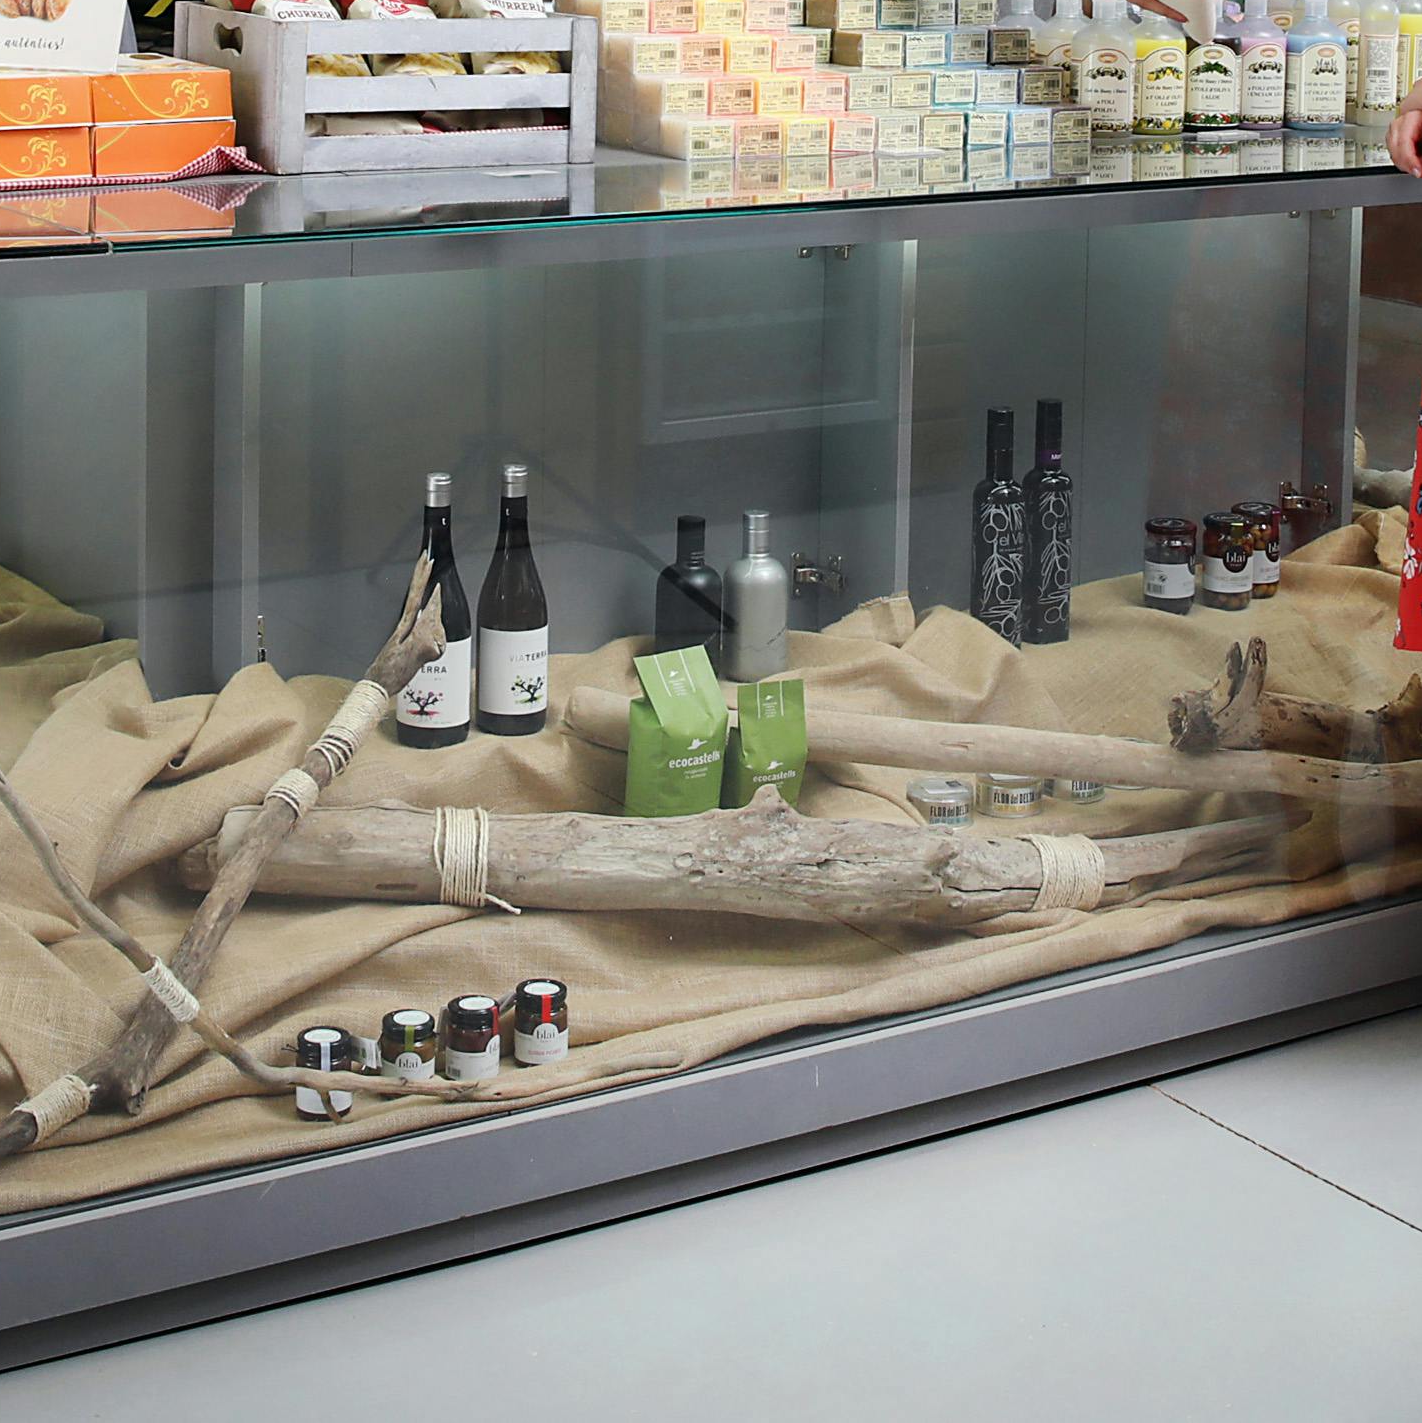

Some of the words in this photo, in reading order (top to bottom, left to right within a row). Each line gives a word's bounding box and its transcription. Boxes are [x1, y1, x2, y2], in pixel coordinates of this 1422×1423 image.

[998, 533, 1010, 547] el
[1225, 551, 1246, 564] blai
[668, 750, 722, 769] ecocastells
[752, 769, 797, 783] ecocastells
[993, 792, 1010, 804] FLOR
[1019, 790, 1036, 804] DELTA
[930, 805, 947, 817] FLOR
[535, 1028, 556, 1040] blai
[398, 1057, 419, 1069] blai
